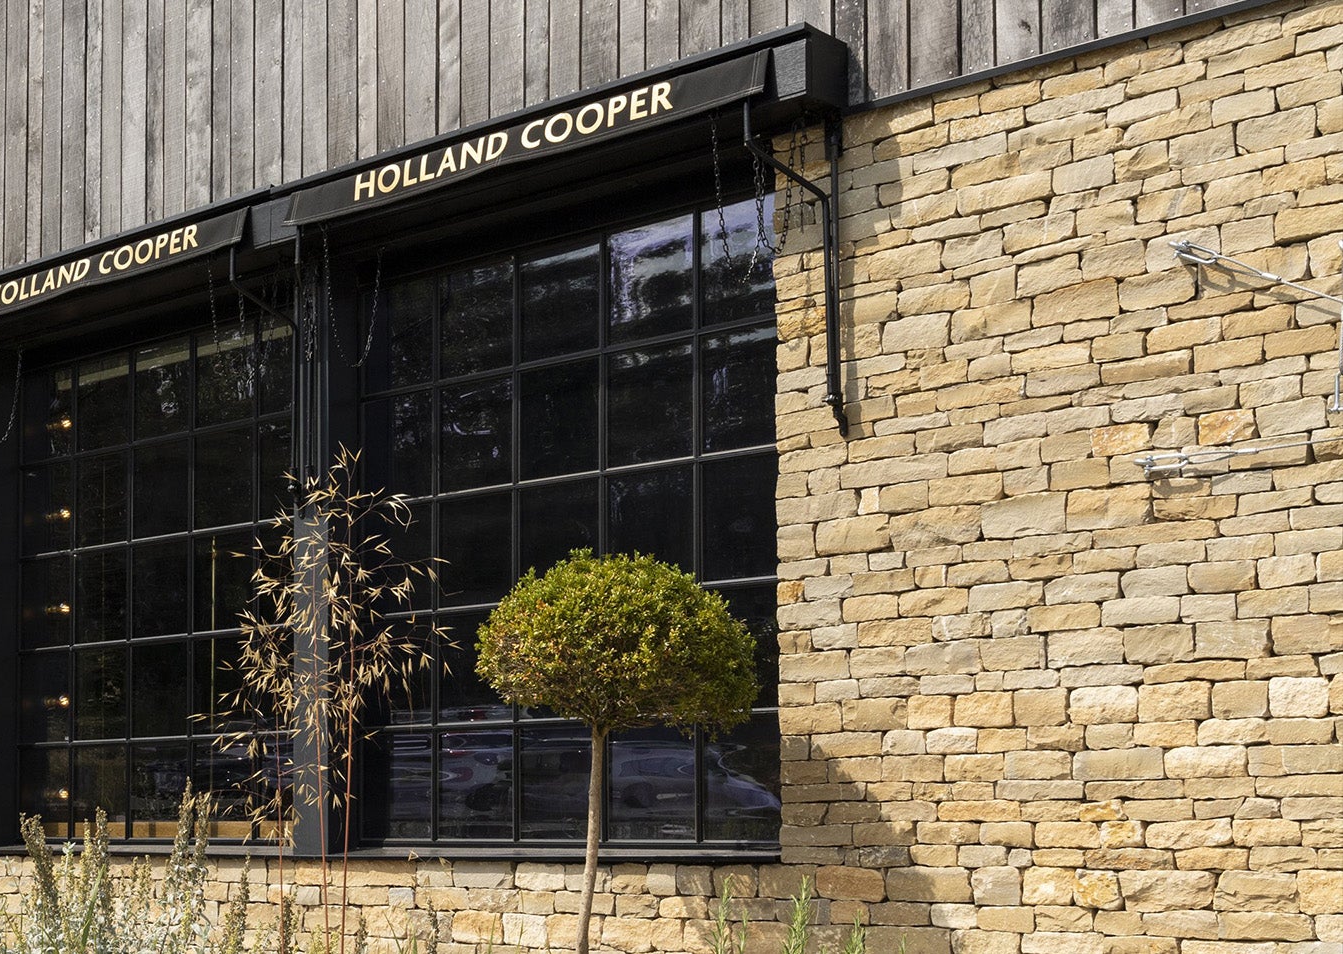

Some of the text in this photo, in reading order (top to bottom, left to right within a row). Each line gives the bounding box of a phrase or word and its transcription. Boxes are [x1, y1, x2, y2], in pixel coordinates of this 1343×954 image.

[353, 82, 673, 201] HOLLAND COOPER
[98, 224, 198, 275] COOPER
